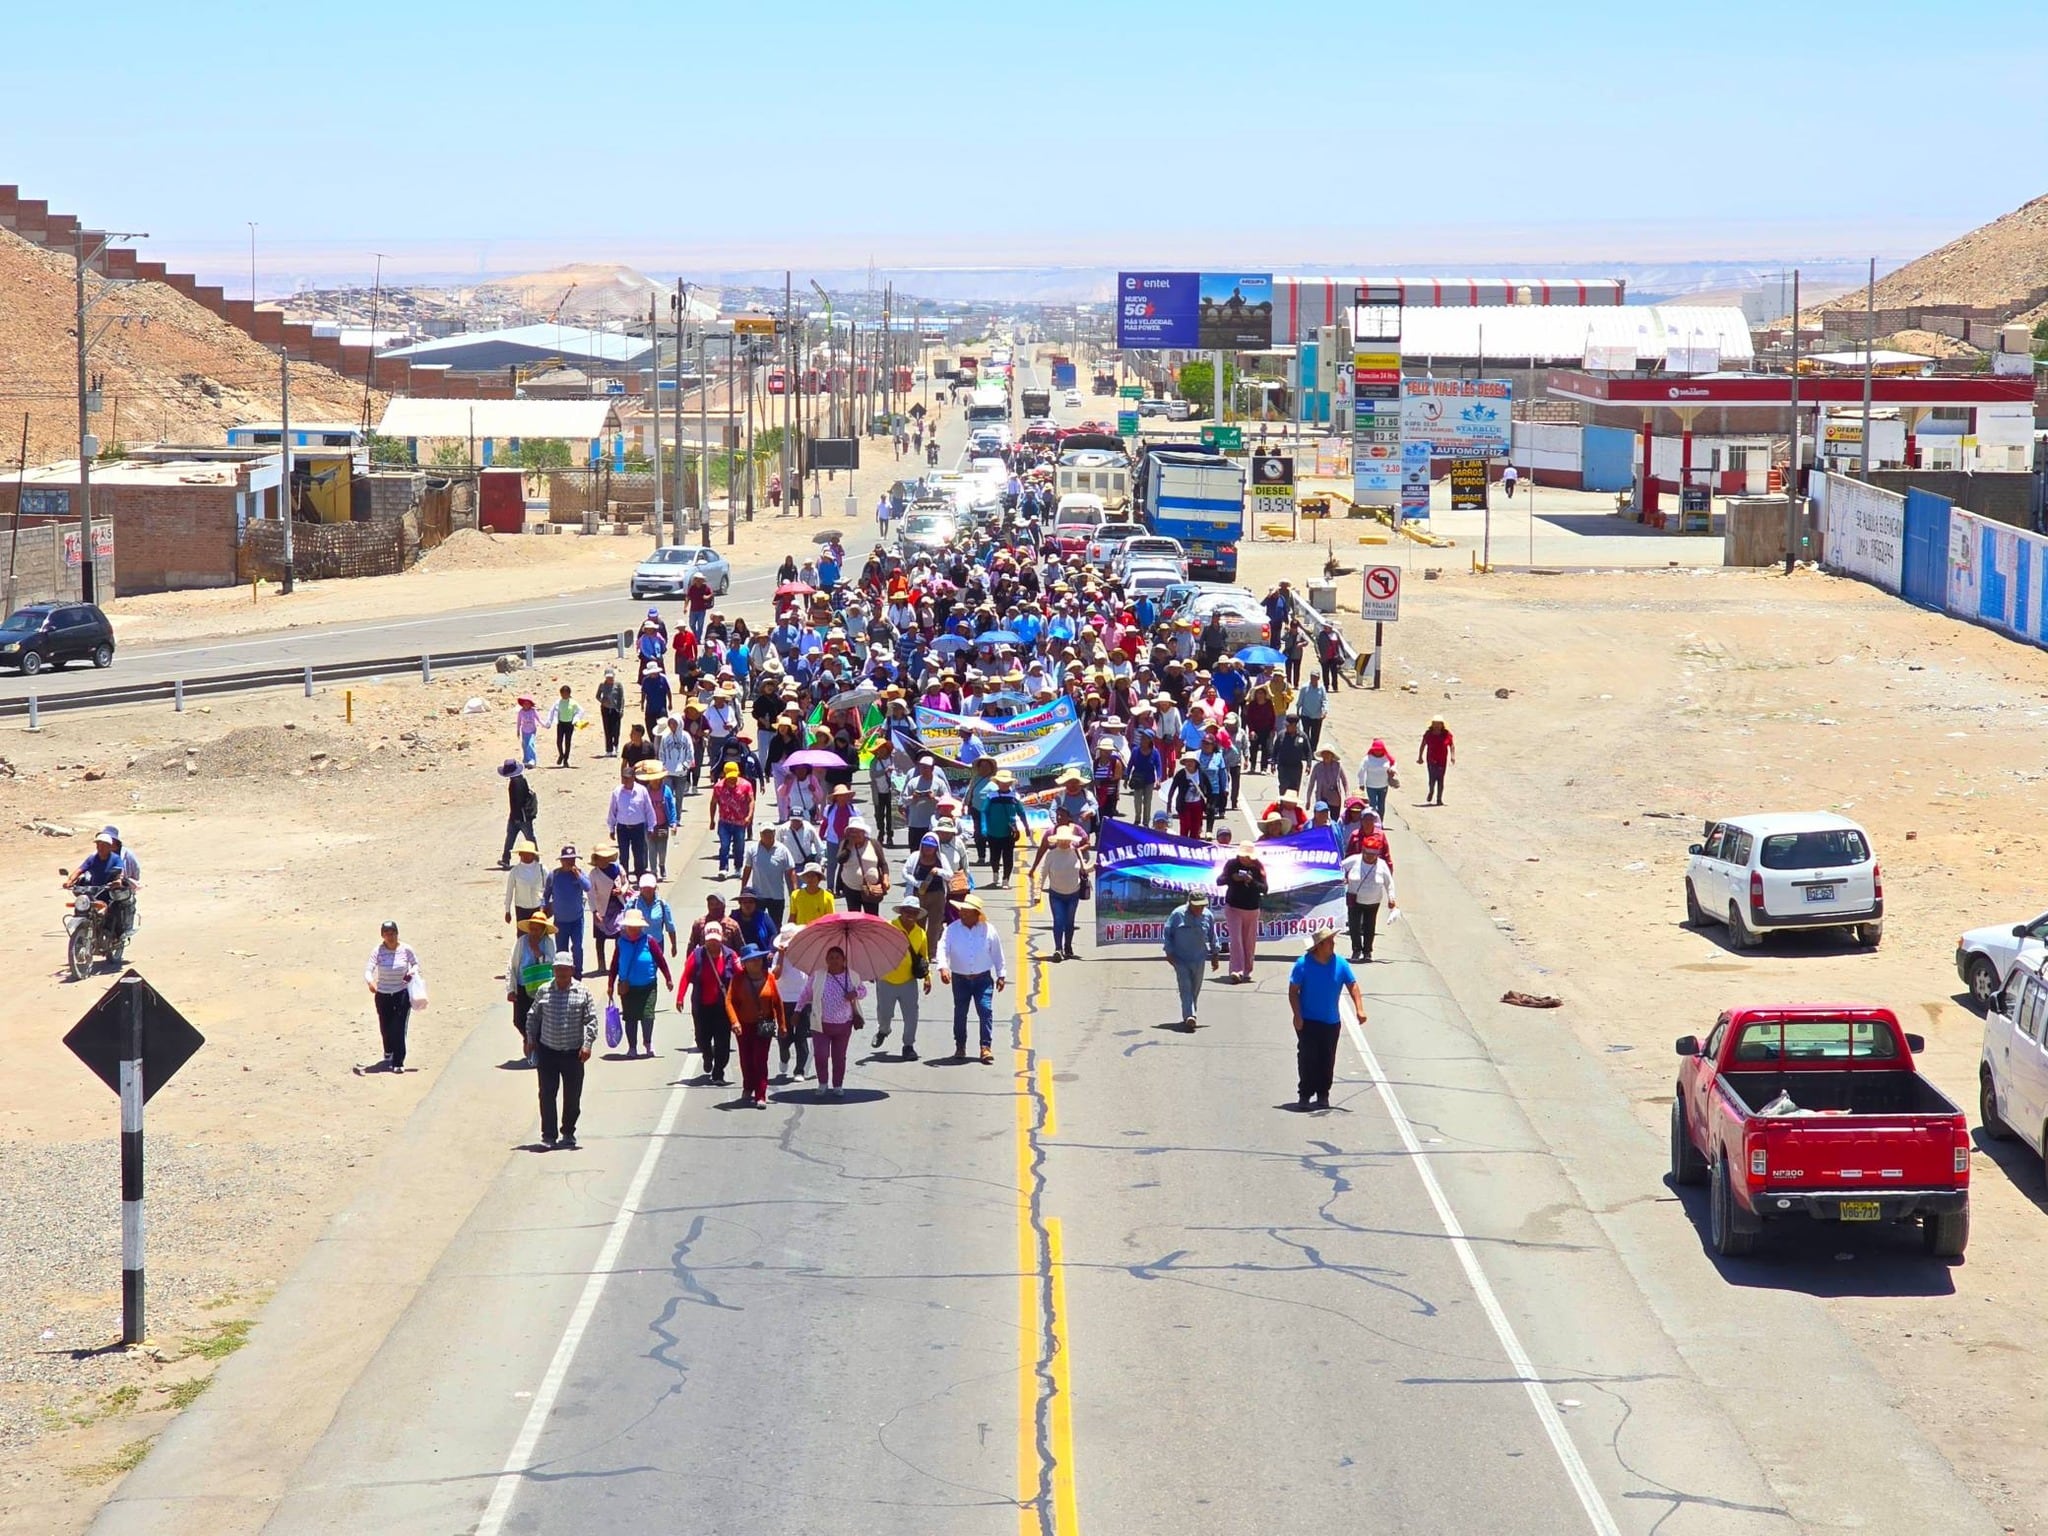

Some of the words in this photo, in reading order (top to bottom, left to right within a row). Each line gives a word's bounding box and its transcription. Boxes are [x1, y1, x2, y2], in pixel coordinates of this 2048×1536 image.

[1144, 279, 1170, 288] entel
[1408, 381, 1430, 395] FELIZ
[1433, 381, 1458, 396] VIAJE
[1461, 382, 1475, 396] LES
[1478, 383, 1506, 397] DESEA
[1436, 446, 1504, 456] AUTOMOTRIZ
[1452, 460, 1460, 468] SE
[1452, 469, 1483, 477] CARROS
[1453, 477, 1485, 486] PESADOS
[1256, 486, 1290, 496] DIESEL
[1268, 916, 1334, 938] 11184924
